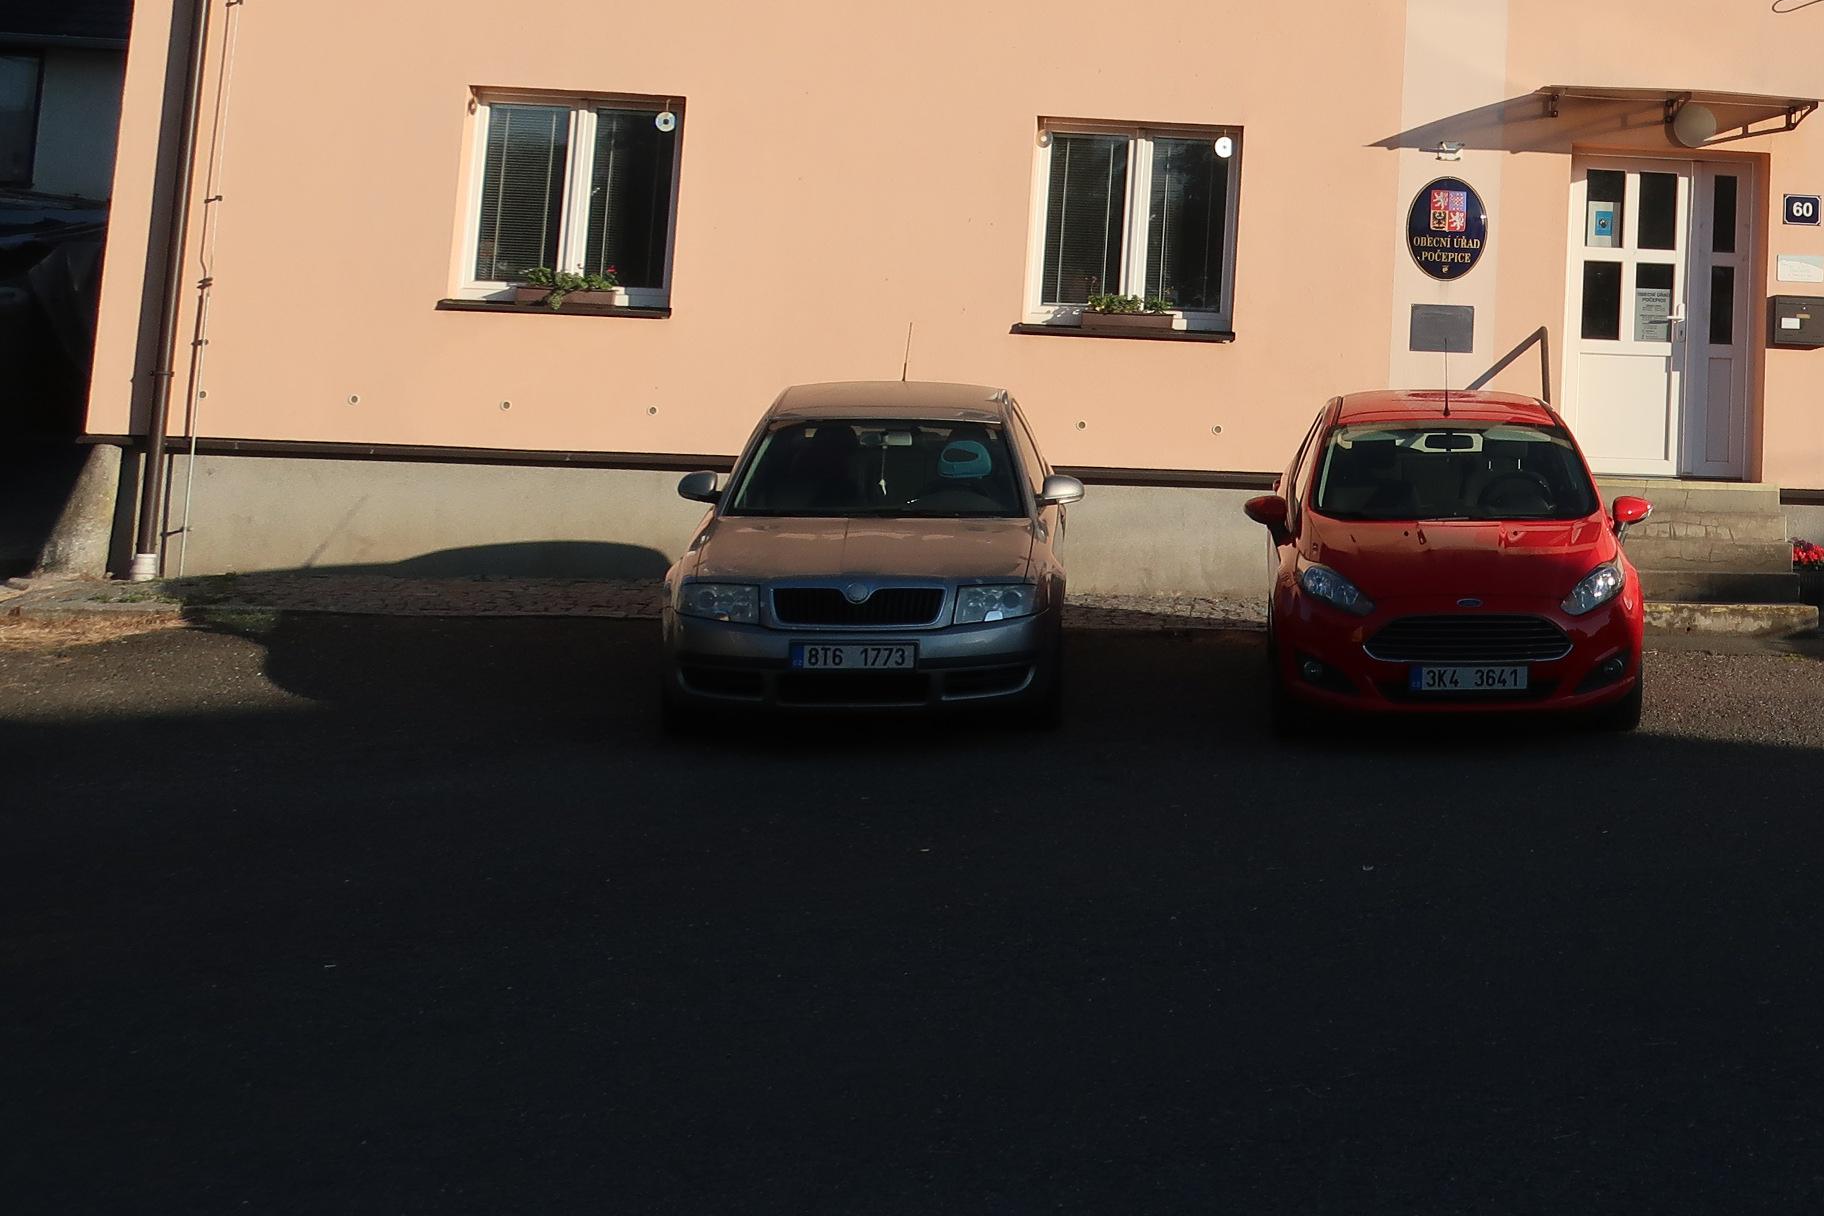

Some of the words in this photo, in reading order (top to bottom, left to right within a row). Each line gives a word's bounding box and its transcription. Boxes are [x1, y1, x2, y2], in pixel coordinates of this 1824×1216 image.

[1792, 202, 1813, 217] 60
[1413, 235, 1451, 248] OBECNÍ
[1453, 236, 1480, 249] ÚŘAD
[1421, 250, 1471, 263] POČEPICE
[807, 647, 844, 666] 8T6
[860, 647, 906, 666] 1773
[1426, 669, 1460, 688] 3K4
[1474, 668, 1519, 687] 3641
